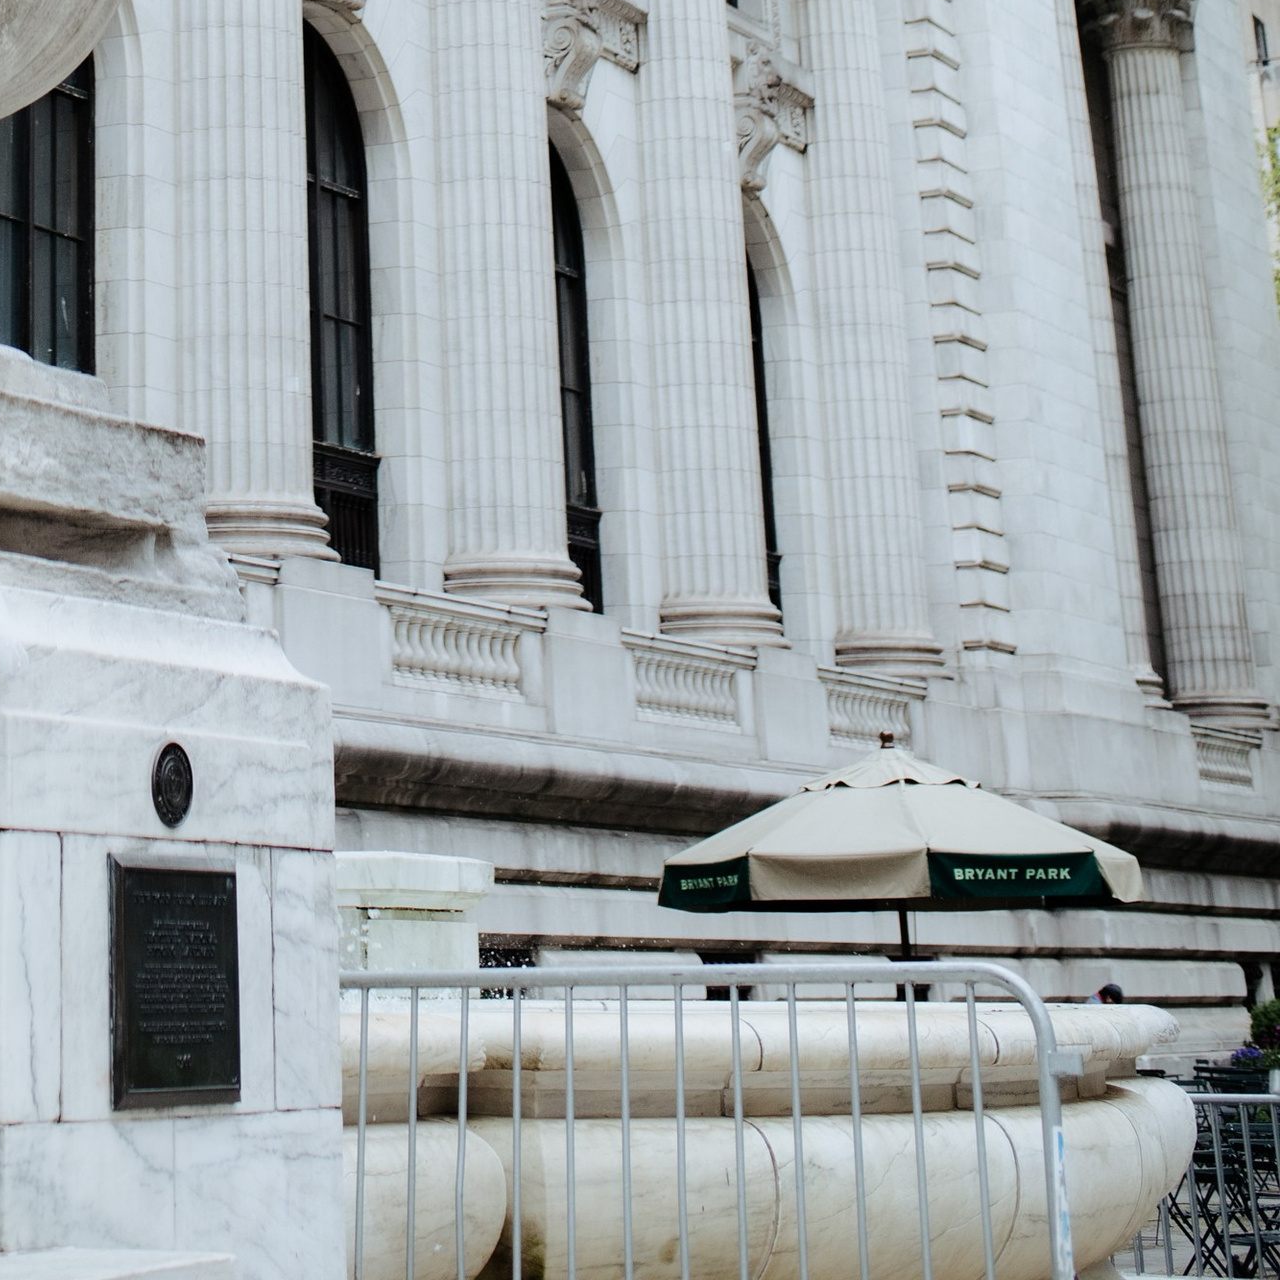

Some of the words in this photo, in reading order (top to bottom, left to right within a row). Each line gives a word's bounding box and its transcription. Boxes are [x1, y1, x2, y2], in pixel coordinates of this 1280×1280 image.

[953, 867, 1019, 881] BRYANT
[1025, 867, 1071, 880] PARK
[680, 877, 715, 891] BRYANT
[716, 874, 739, 888] PARK
